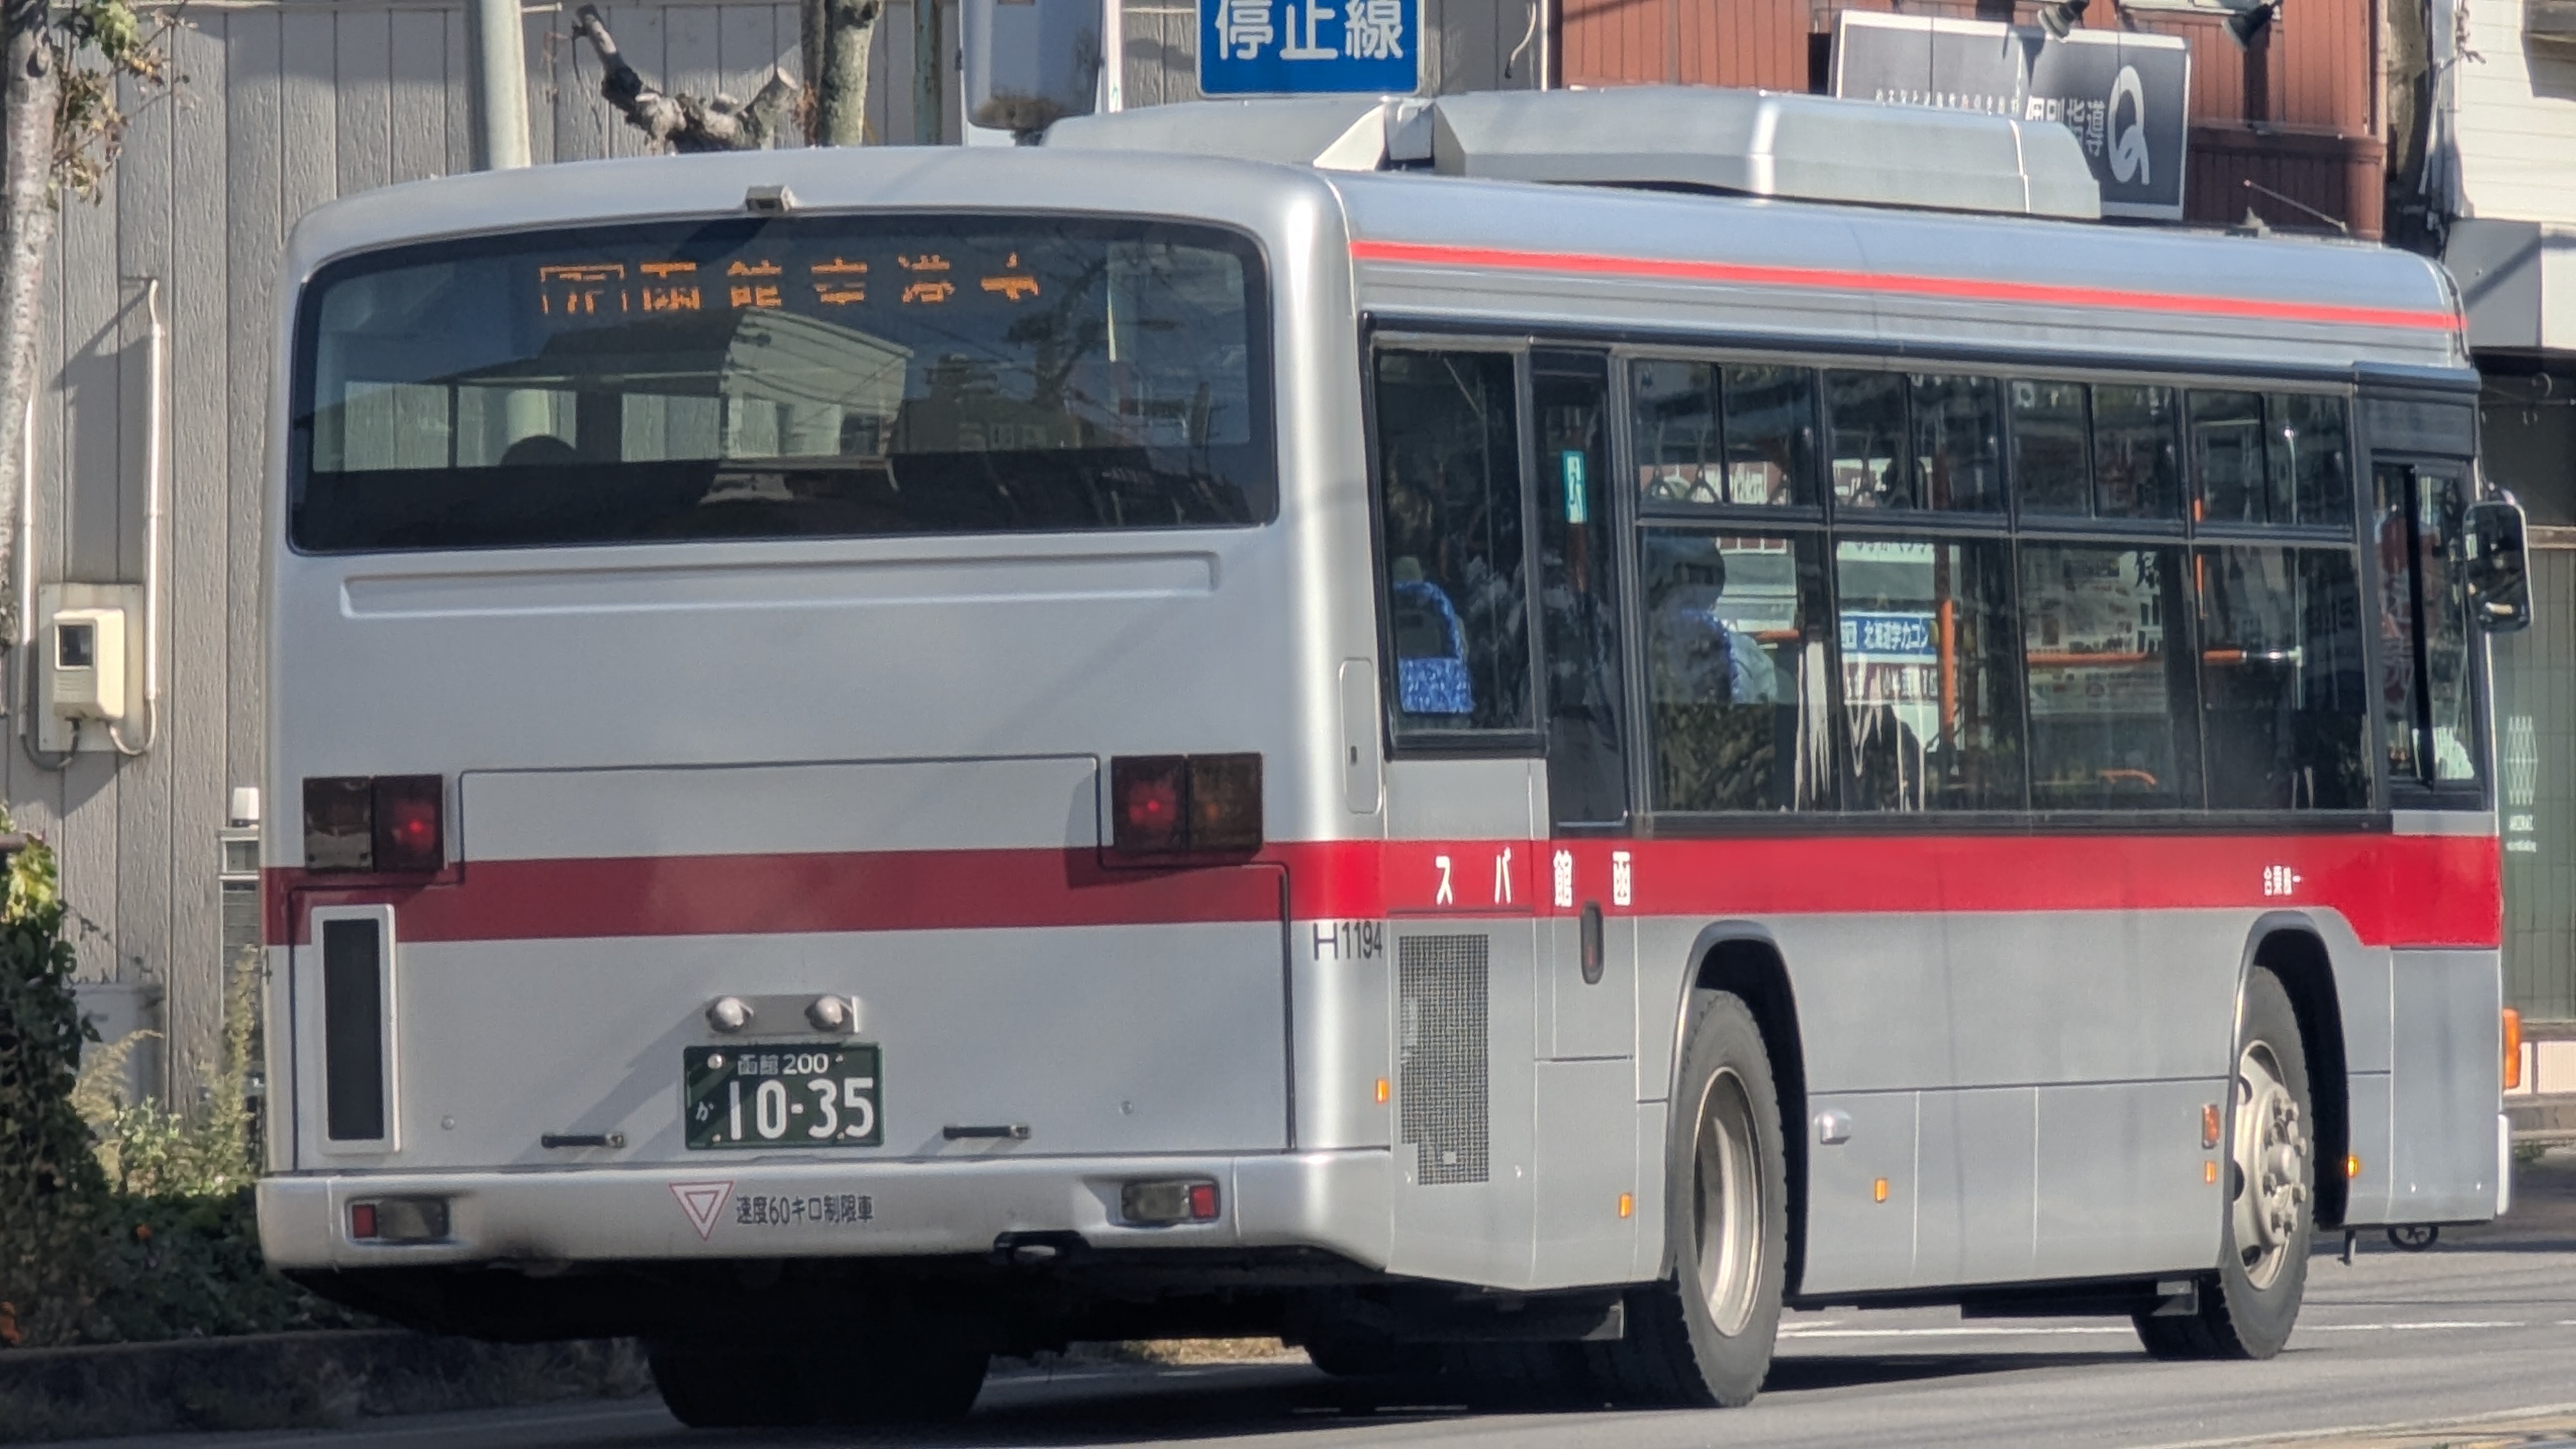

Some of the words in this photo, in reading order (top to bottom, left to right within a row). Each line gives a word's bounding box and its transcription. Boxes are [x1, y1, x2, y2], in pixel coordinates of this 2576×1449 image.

[1215, 0, 1405, 61] 停止線
[1313, 921, 1383, 960] H1194
[783, 1054, 828, 1075] 200
[729, 1077, 874, 1140] 10-35
[736, 1195, 874, 1225] 速度60キロ制限車
